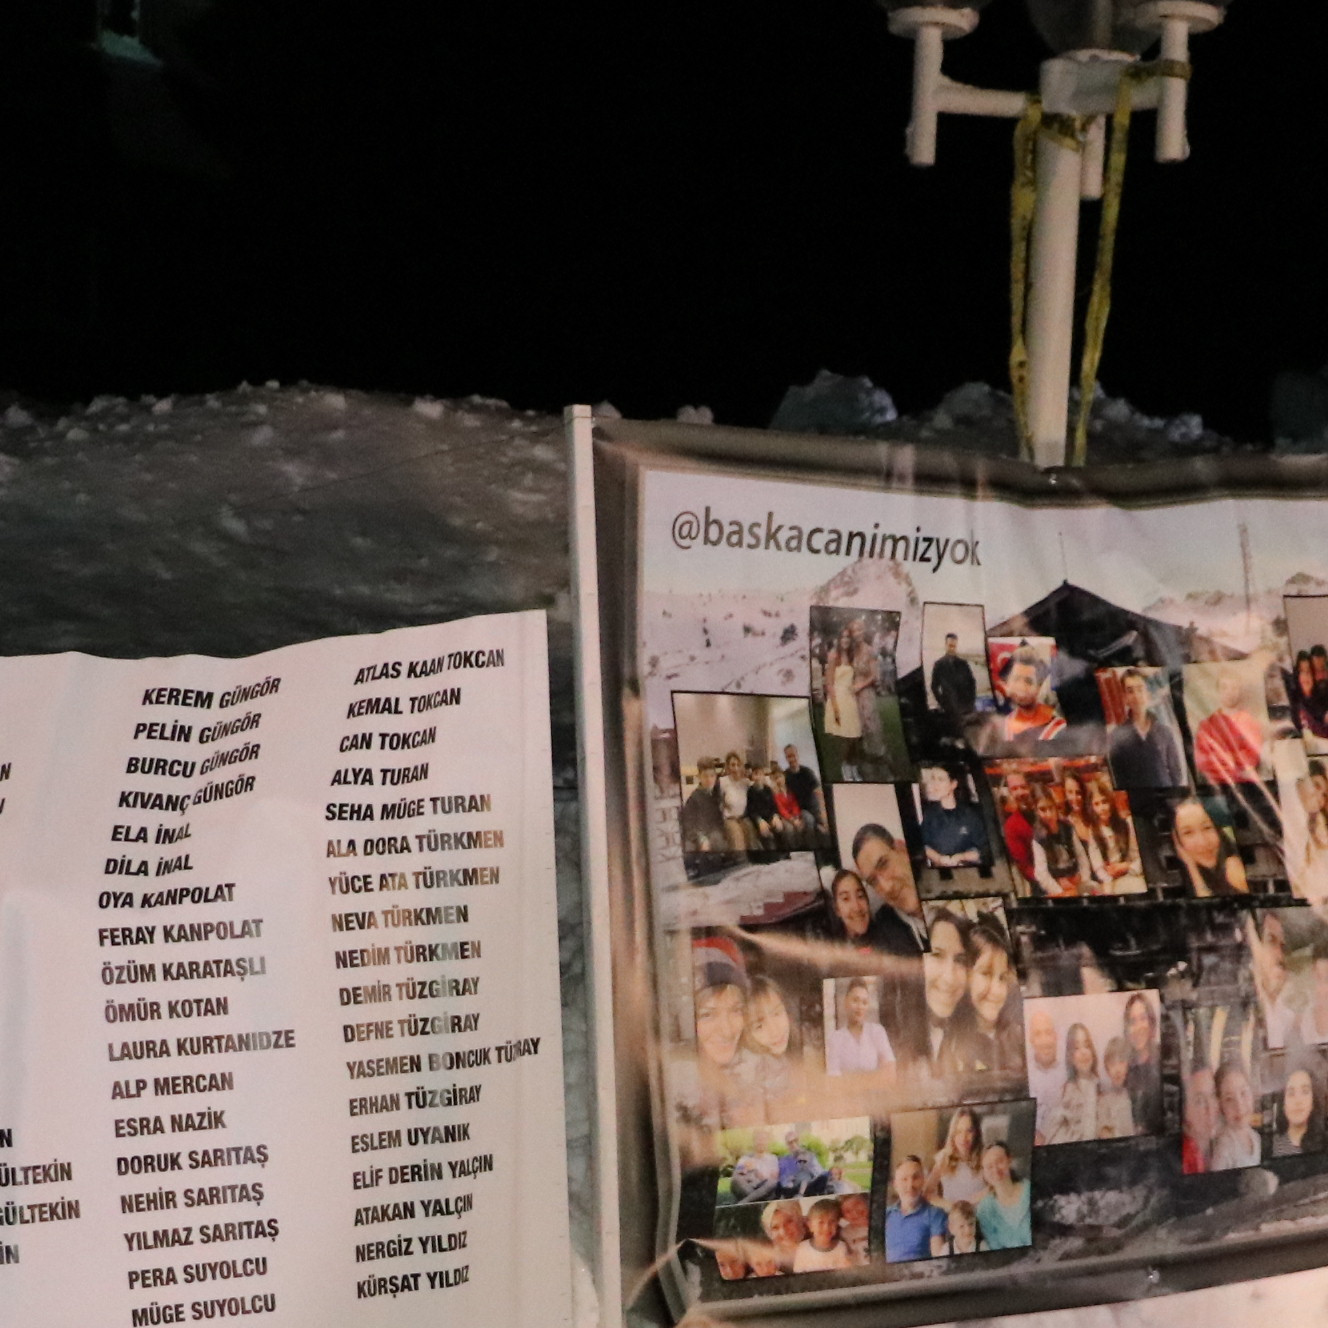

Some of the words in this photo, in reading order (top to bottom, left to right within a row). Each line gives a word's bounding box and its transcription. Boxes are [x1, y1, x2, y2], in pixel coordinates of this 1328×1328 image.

[672, 506, 981, 573] @baskacanimizyok
[327, 839, 357, 858] ALA
[363, 836, 412, 856] DORA
[415, 829, 503, 852] TÜRKMEN
[329, 872, 374, 894] YÜCE
[379, 873, 407, 891] ATA
[413, 866, 499, 889] TÜRKMEN
[98, 891, 134, 909] OYA
[140, 883, 235, 909] KANPOLAT
[98, 926, 156, 947] FERAY
[163, 919, 263, 943] KANPOLAT
[332, 911, 377, 931] NEVA
[382, 905, 468, 927] TÜRKMEN
[335, 947, 390, 969] NEDİM
[394, 941, 481, 963] TÜRKMEN
[101, 960, 156, 985] ÖZÜM
[162, 958, 266, 981] KARATAŞLI
[339, 981, 391, 1006] DEMİR
[396, 977, 479, 1000] TÜZGİRAY
[105, 998, 162, 1023] ÖMÜR
[168, 997, 228, 1019] KOTAN
[343, 1021, 393, 1043] DEFNE
[398, 1013, 480, 1036] TÜZGİRAY
[108, 1039, 171, 1061] LAURA
[177, 1030, 295, 1056] KURTANIDZE
[112, 1079, 147, 1100] ALP
[154, 1072, 233, 1096] MERCAN
[349, 1093, 400, 1117] ERHAN
[404, 1084, 481, 1109] TÜZGİRAY
[115, 1116, 165, 1138] ESRA
[171, 1107, 226, 1133] NAZİK
[351, 1130, 402, 1153] ESLEM
[407, 1123, 470, 1146] UYANIK
[117, 1152, 183, 1176] DORUK
[188, 1145, 268, 1169] SARITAŞ
[353, 1166, 383, 1190] ELİF
[388, 1159, 443, 1185] DERİN
[448, 1154, 493, 1179] YALÇIN
[121, 1187, 177, 1214] NEHİR
[183, 1183, 264, 1208] SARITAŞ
[124, 1227, 194, 1251] YILMAZ
[199, 1218, 279, 1244] SARITAŞ
[128, 1267, 178, 1290] PERA
[183, 1257, 267, 1283] SUYOLCU
[132, 1302, 185, 1327] MÜGE
[191, 1293, 276, 1320] SUYOLCU
